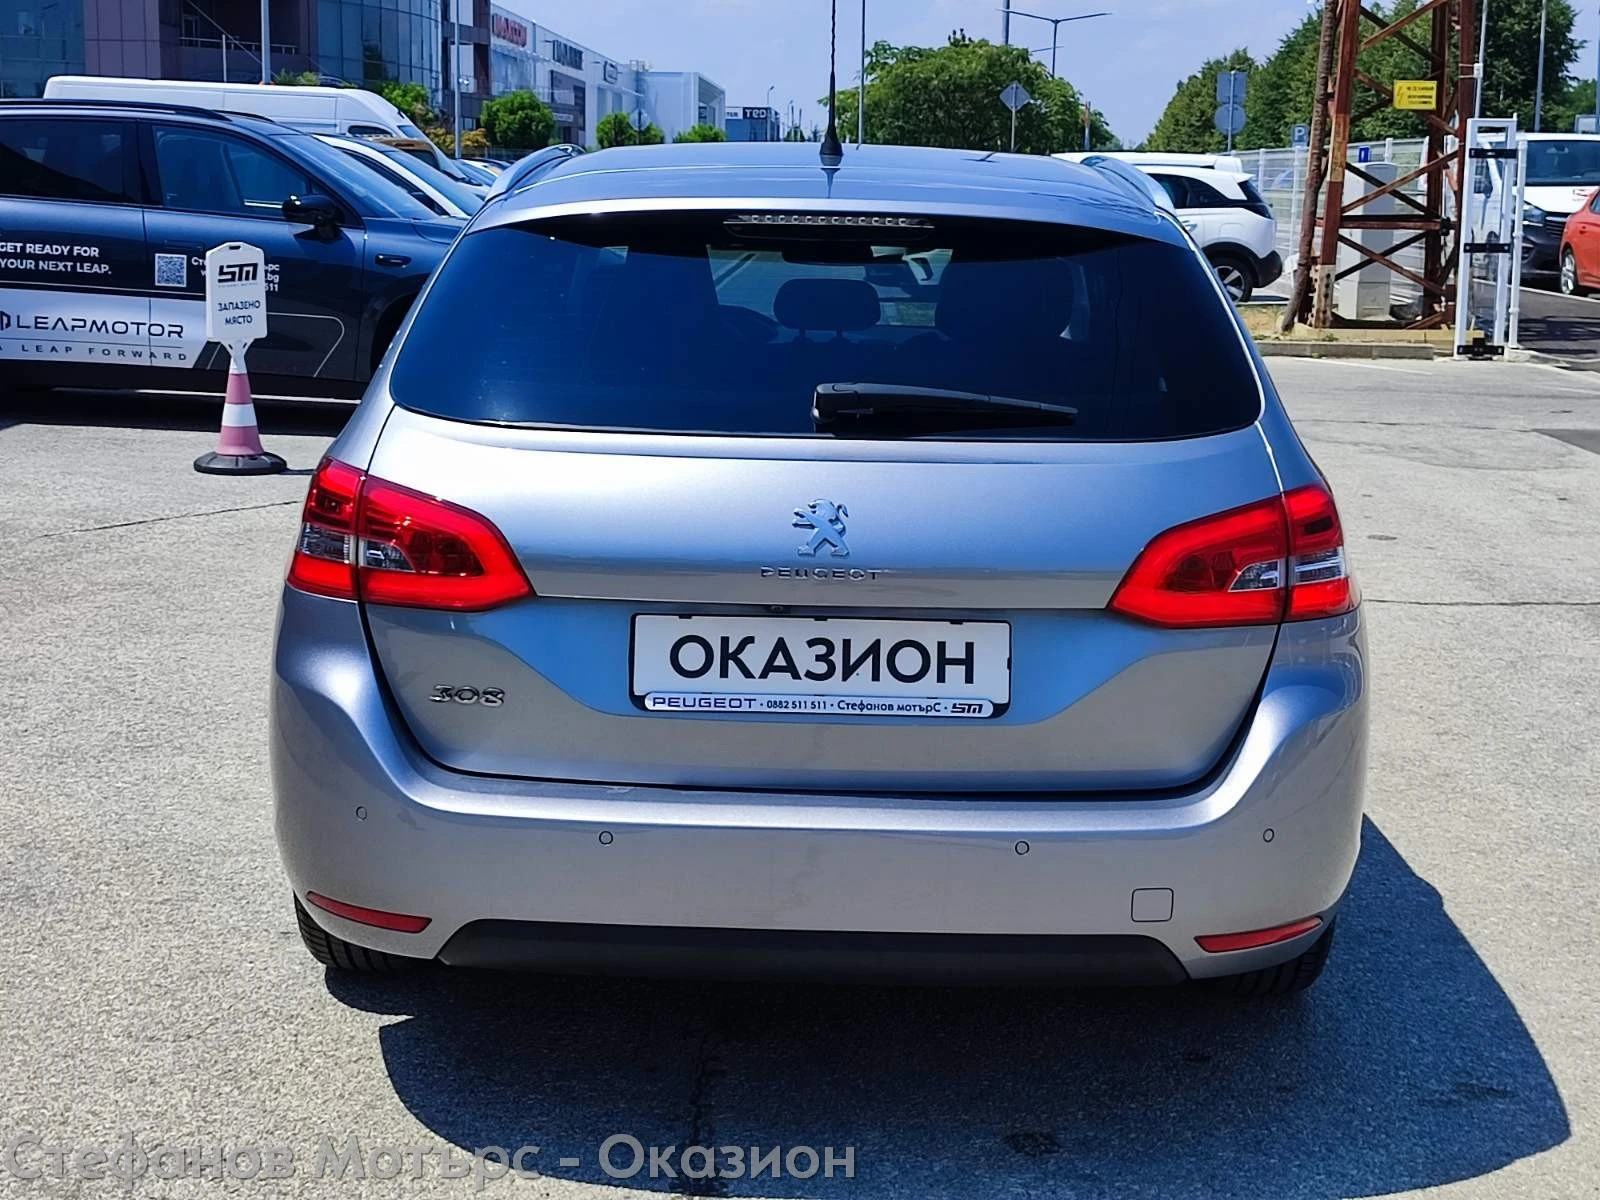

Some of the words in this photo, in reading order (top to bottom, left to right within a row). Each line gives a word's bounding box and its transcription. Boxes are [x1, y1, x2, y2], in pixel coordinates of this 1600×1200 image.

[0, 242, 23, 253] GET
[26, 243, 70, 256] READY
[73, 246, 100, 257] FOR
[0, 258, 35, 270] YOUR
[38, 260, 74, 272] NEXT
[76, 262, 112, 275] LEAP.
[217, 300, 261, 312] ЗАПАЗЕНО
[16, 315, 184, 339] LEAPMOTOR
[225, 315, 253, 326] МЯСТО
[21, 344, 73, 354] LEAP
[88, 347, 187, 362] FORWARD
[760, 566, 881, 581] PEUGEOT
[669, 634, 975, 685] ОКАЗИОН
[428, 683, 506, 708] 308
[652, 697, 757, 709] PEUGEOT
[766, 700, 790, 709] 0882
[791, 700, 808, 709] 511
[810, 701, 827, 710] 511
[837, 700, 894, 713] Стефанов
